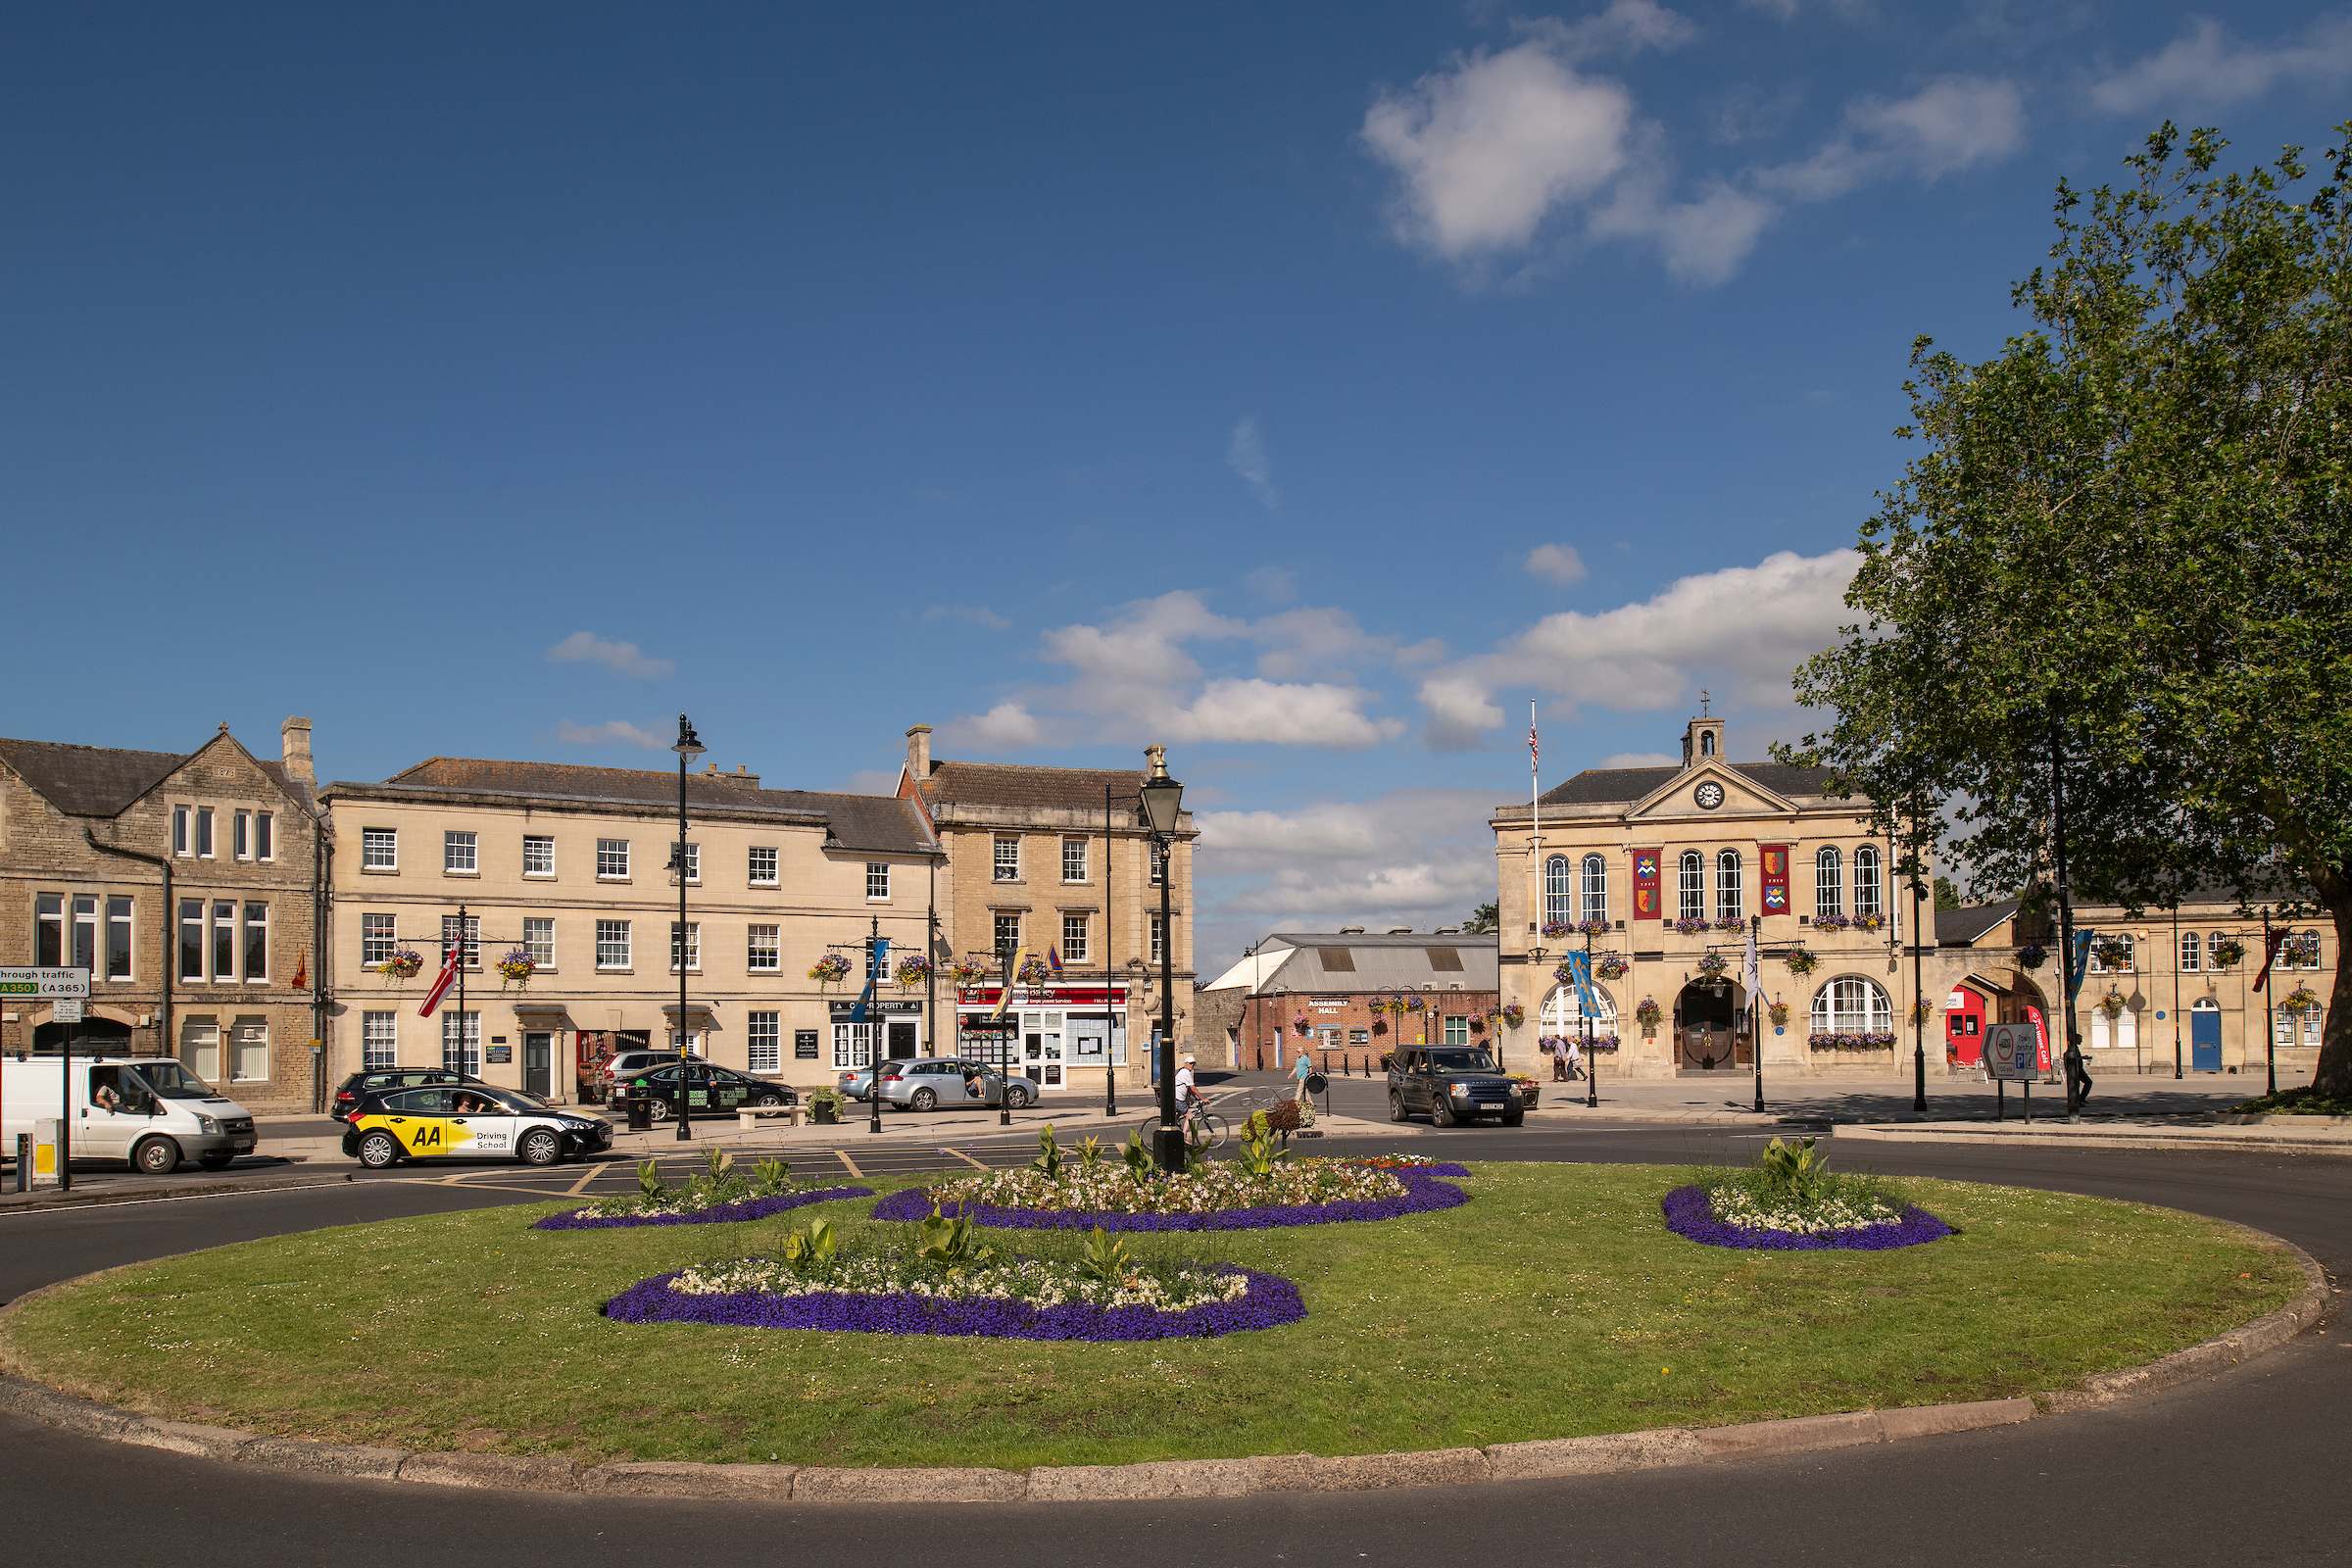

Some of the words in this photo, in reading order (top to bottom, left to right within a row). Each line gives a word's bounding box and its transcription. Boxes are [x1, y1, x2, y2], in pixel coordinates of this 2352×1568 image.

[0, 970, 37, 979] hrough
[42, 970, 74, 979] traffic
[2035, 1030, 2044, 1050] House
[412, 1126, 440, 1147] AA
[476, 1132, 507, 1141] Driving
